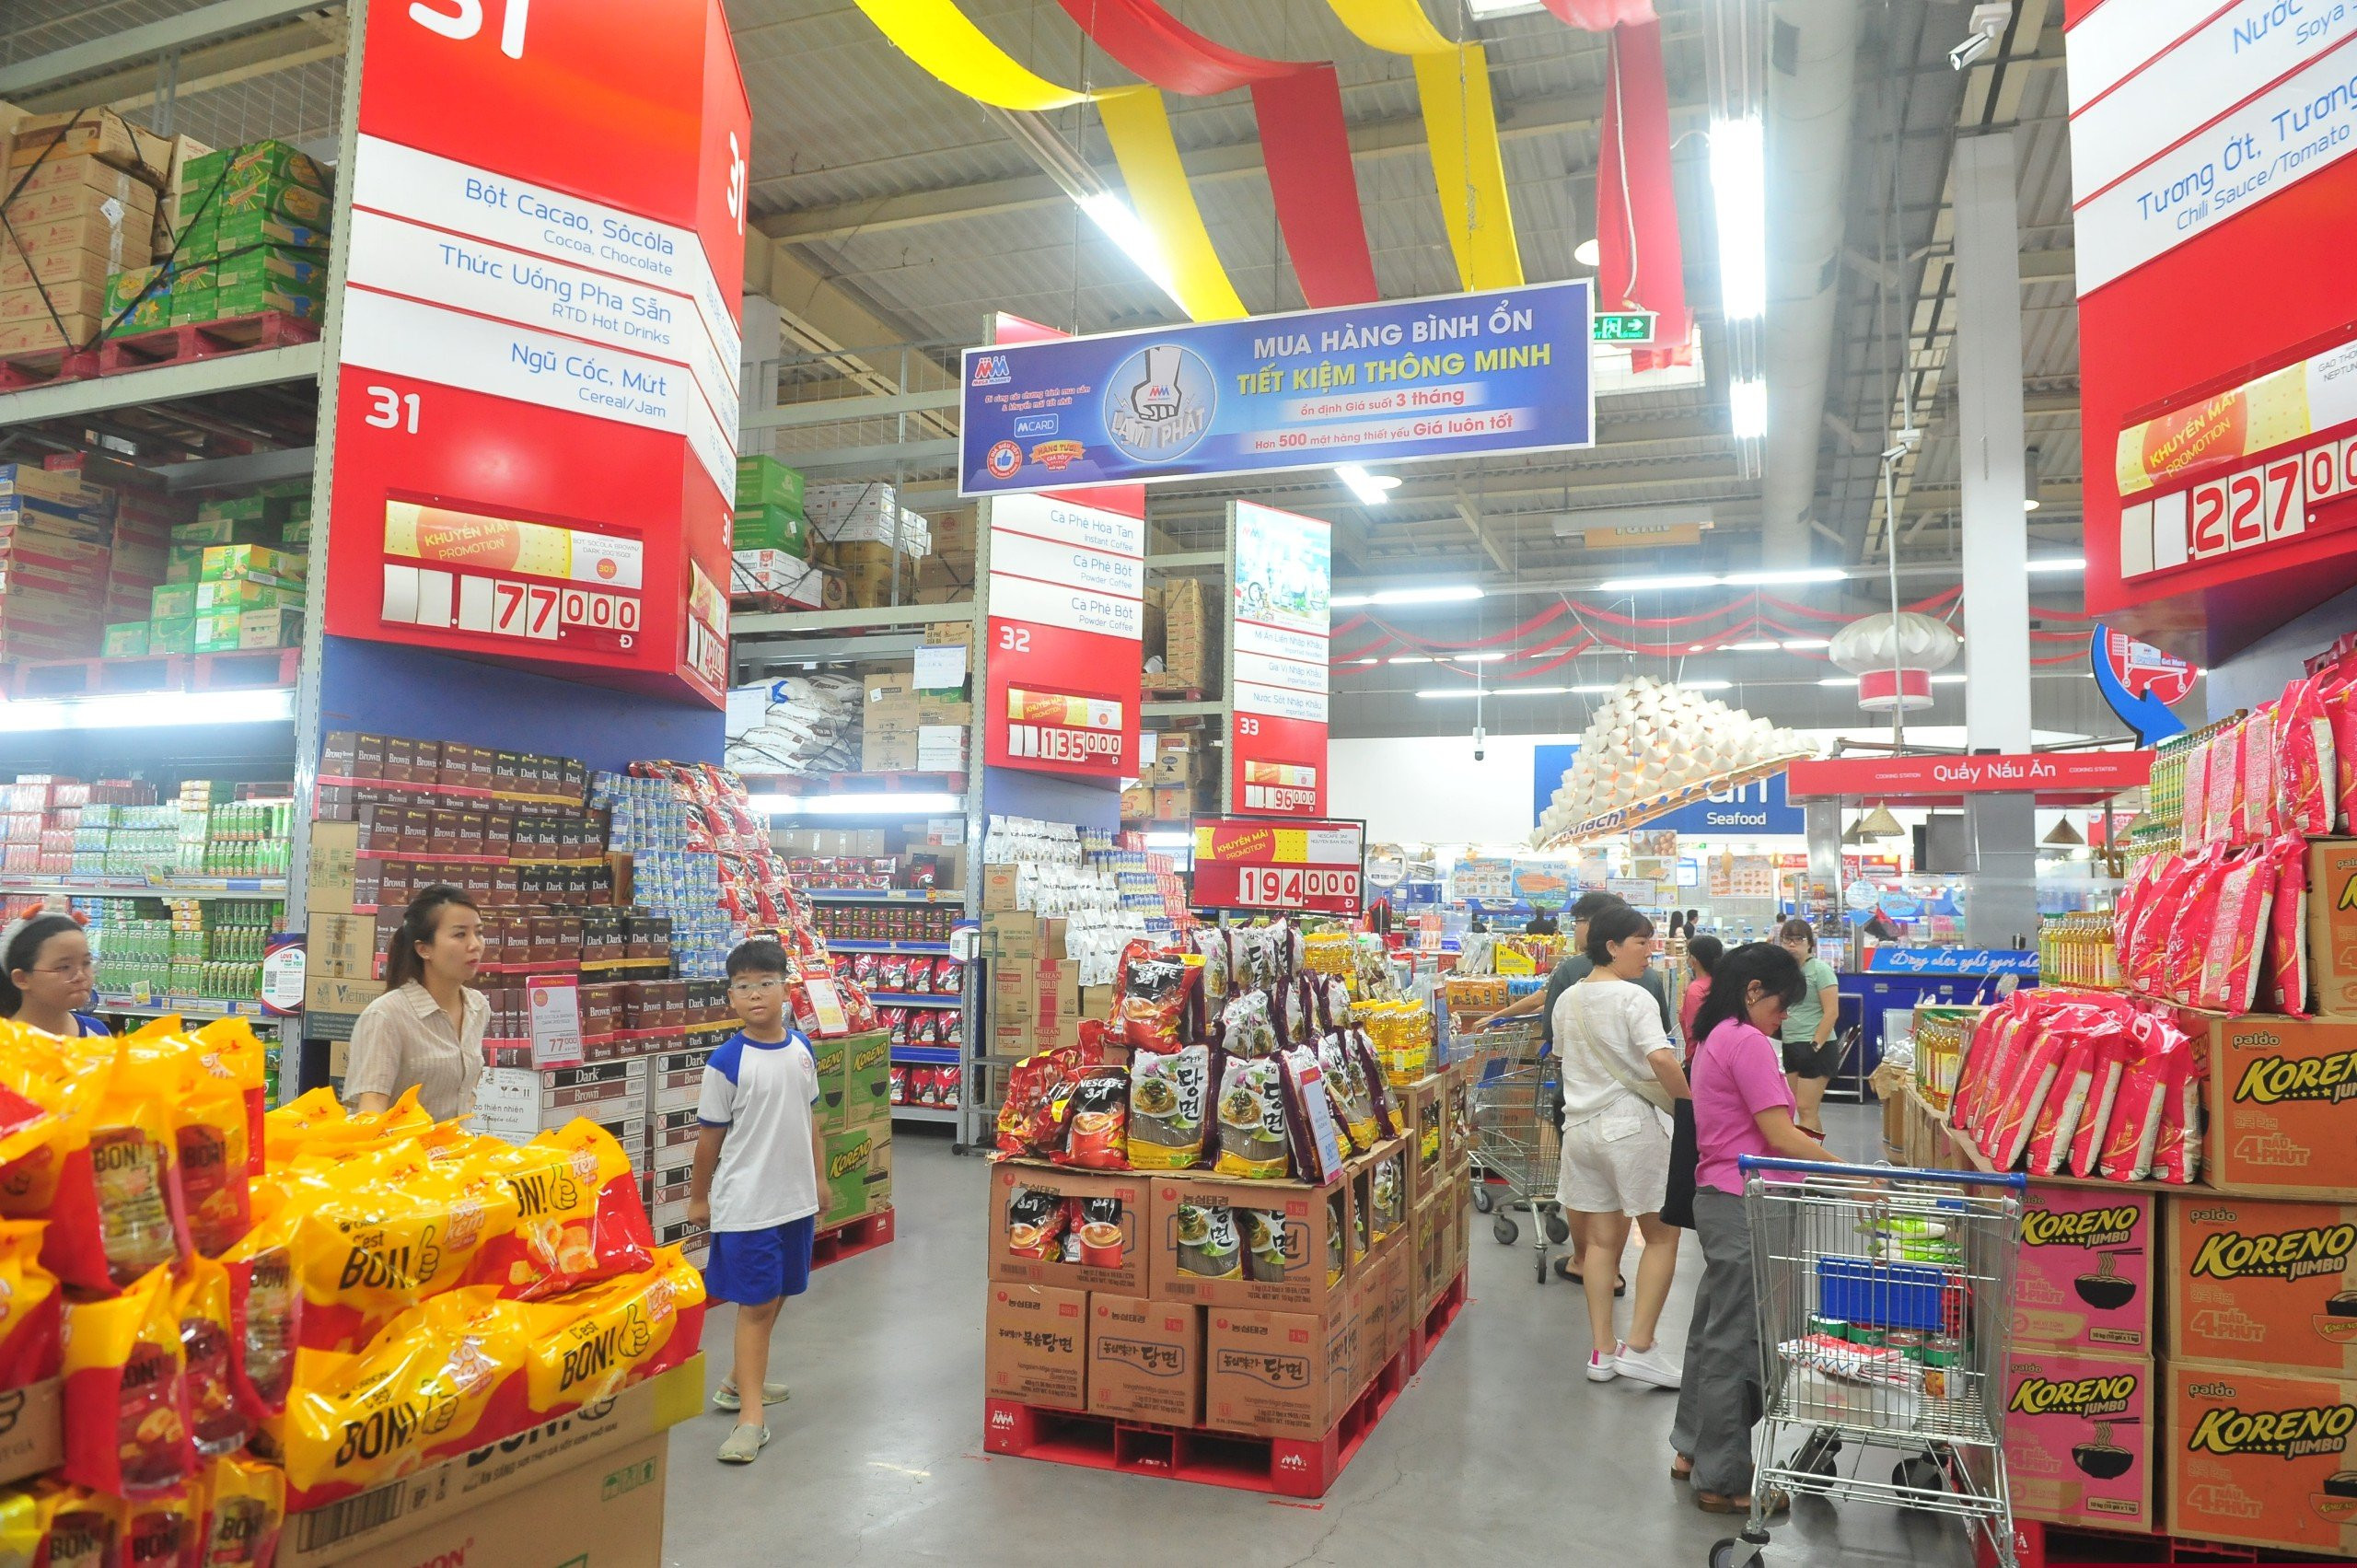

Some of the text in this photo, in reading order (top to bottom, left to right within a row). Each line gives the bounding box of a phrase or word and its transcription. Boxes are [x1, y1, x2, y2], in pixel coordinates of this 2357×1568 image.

[2297, 6, 2344, 45] Soya
[2177, 124, 2351, 230] Chili Sauce/Tomato
[2138, 164, 2214, 221] Tương
[465, 178, 674, 255] Bột Cacao, Sôcôla
[543, 230, 673, 276] Cocoa, Chocolate
[439, 244, 671, 324] Thức Uống Pha Sẵn
[552, 304, 670, 345] RTD Hot Drinks
[1254, 299, 1533, 359] MUA HÀNG BÌNH ỔN
[512, 343, 668, 397] Ngũ Cốc, Mứt
[1237, 343, 1550, 395] TIẾT KIỆM THÔNG MINH
[366, 386, 420, 435] 31
[578, 388, 667, 419] Cereal/Jam
[1301, 389, 1465, 416] ổn định Giá suốt 3 tháng
[1255, 413, 1514, 449] Hơn 500 mặt hàng thiết yếu Giá luôn tốt
[2150, 415, 2205, 468] KHUYẾN
[2166, 418, 2231, 477] PROMOTION
[424, 522, 482, 547] KHUYẾN
[1085, 534, 1132, 552] Instant Coffee
[1116, 525, 1133, 539] Tan
[438, 538, 505, 561] PROMOTION
[1081, 573, 1132, 589] Powder Coffee
[1079, 615, 1132, 632] Powder Coffee
[999, 626, 1030, 653] 32
[1269, 662, 1279, 671] Gia
[1239, 717, 1259, 736] 33
[359, 750, 380, 761] Brown
[389, 754, 410, 764] Brown
[497, 765, 516, 776] Dark
[520, 768, 537, 779] Dark
[1933, 759, 2056, 784] Quầy Nấu Ăn
[375, 823, 398, 833] Brown
[1707, 812, 1766, 825] Seafood
[405, 825, 426, 836] Brown
[517, 832, 533, 842] Dark
[1217, 829, 1269, 854] KHUYẾN MÃI
[1226, 842, 1266, 860] PROMOTION
[383, 877, 406, 888] Brown
[523, 881, 540, 891] Dark
[508, 936, 528, 947] Brown
[1040, 981, 1056, 989] GOLD
[590, 1007, 610, 1016] Brown
[2233, 1031, 2281, 1051] paldo
[685, 1052, 705, 1067] Dark
[853, 1042, 887, 1072] KORENO
[575, 1070, 599, 1084] Dark
[575, 1089, 599, 1101] Brown
[830, 1139, 872, 1179] KORENO
[2021, 1206, 2140, 1245] KORENO
[2190, 1207, 2236, 1225] paldo
[2085, 1230, 2131, 1249] JUMBO
[2192, 1225, 2355, 1278] KORENO
[2288, 1258, 2345, 1281] JUMBO
[568, 1320, 598, 1338] C'est
[559, 1328, 616, 1392] BON!
[1143, 1346, 1178, 1368] 당면
[1264, 1358, 1304, 1380] 당면
[2011, 1365, 2042, 1373] paldo
[2010, 1376, 2135, 1413] KORENO
[2188, 1383, 2235, 1398] paldo
[2083, 1401, 2126, 1417] JUMBO
[334, 1401, 417, 1469] BON!
[2190, 1406, 2355, 1452] KORENO
[2285, 1437, 2344, 1459] JUMBO
